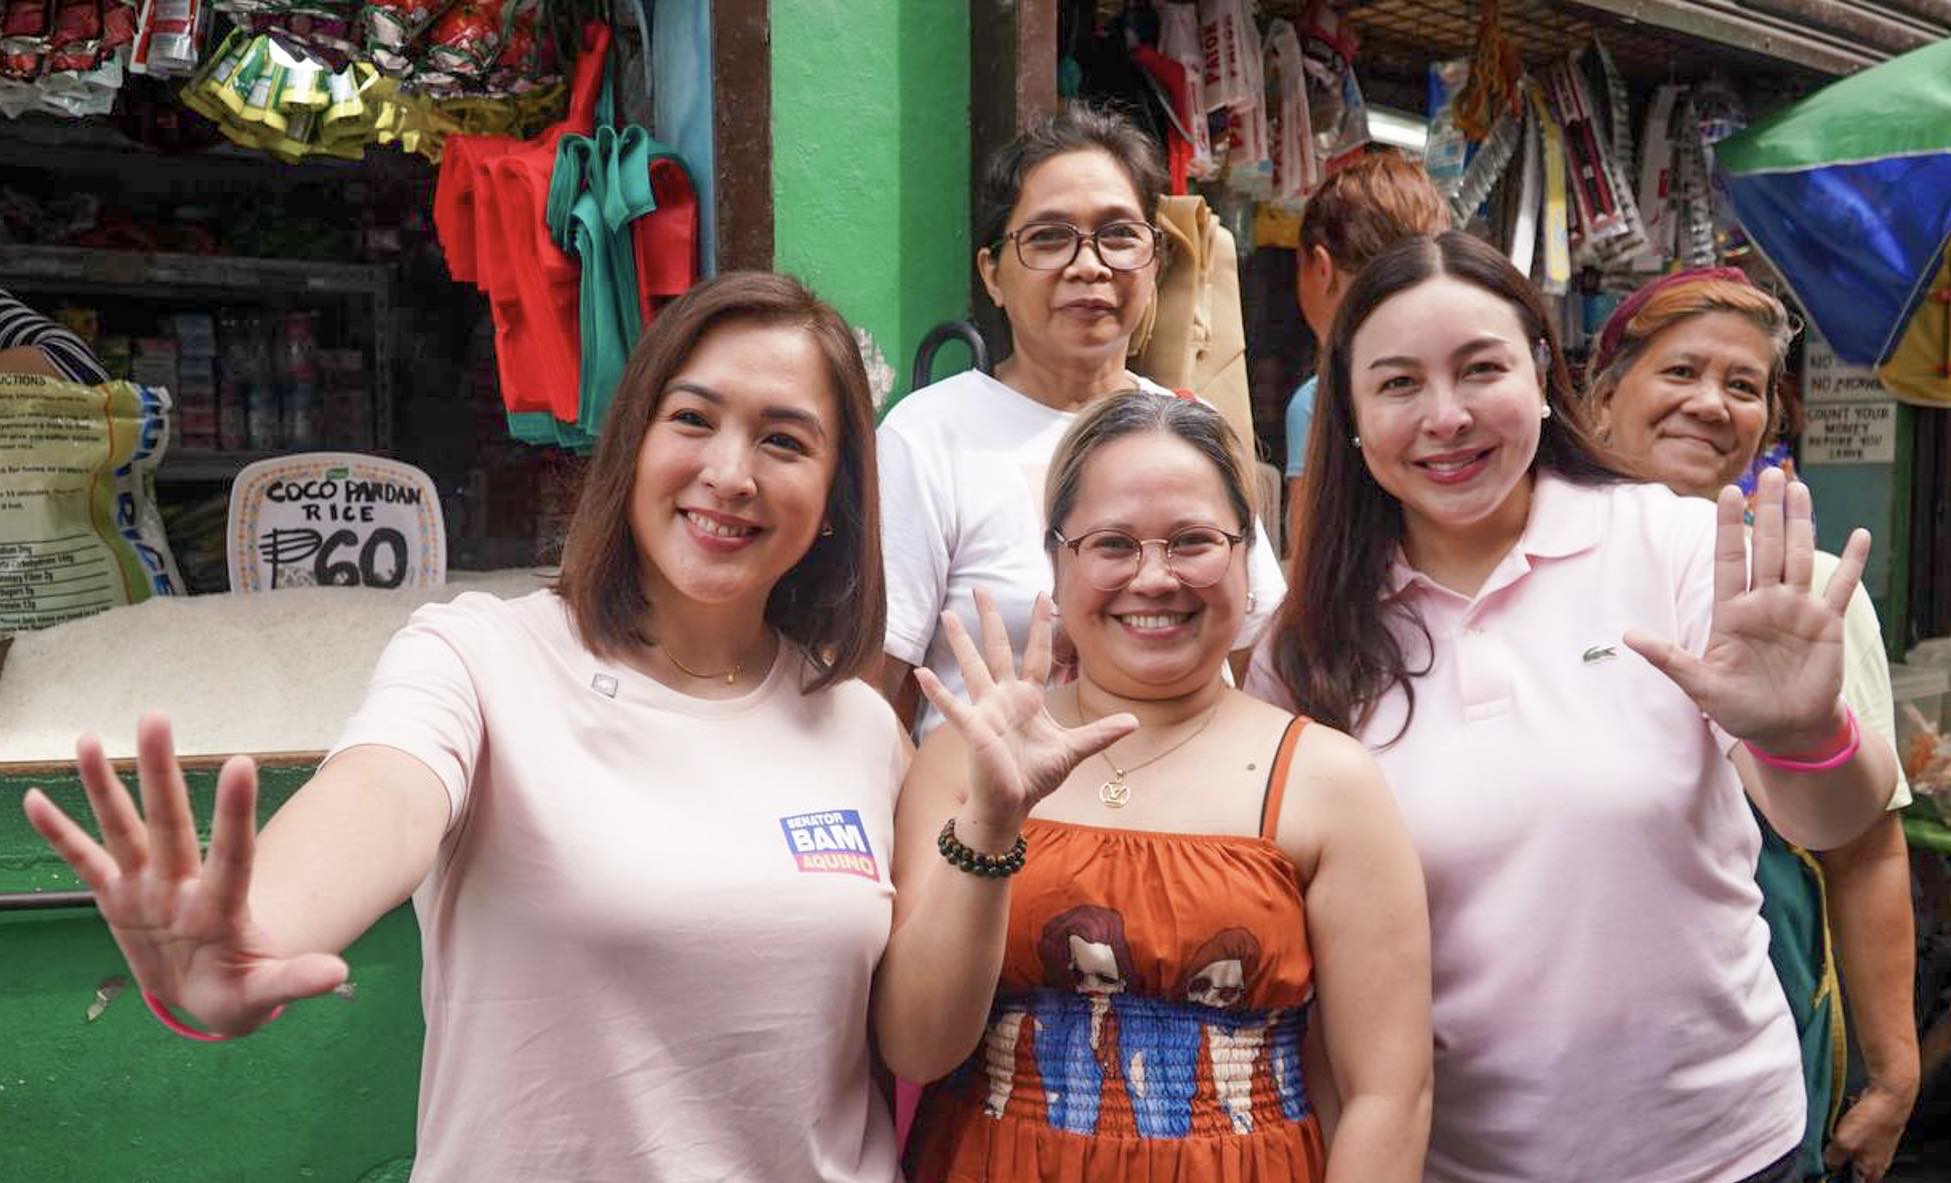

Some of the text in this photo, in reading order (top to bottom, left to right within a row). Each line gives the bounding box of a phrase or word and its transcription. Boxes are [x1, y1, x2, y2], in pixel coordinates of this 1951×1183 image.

[1808, 408, 1889, 421] COUNT YOUR
[267, 479, 337, 503] COCO
[302, 504, 374, 523] RICE
[787, 813, 844, 829] SENATOR
[791, 825, 867, 852] BAM
[802, 854, 875, 877] AQUINO
